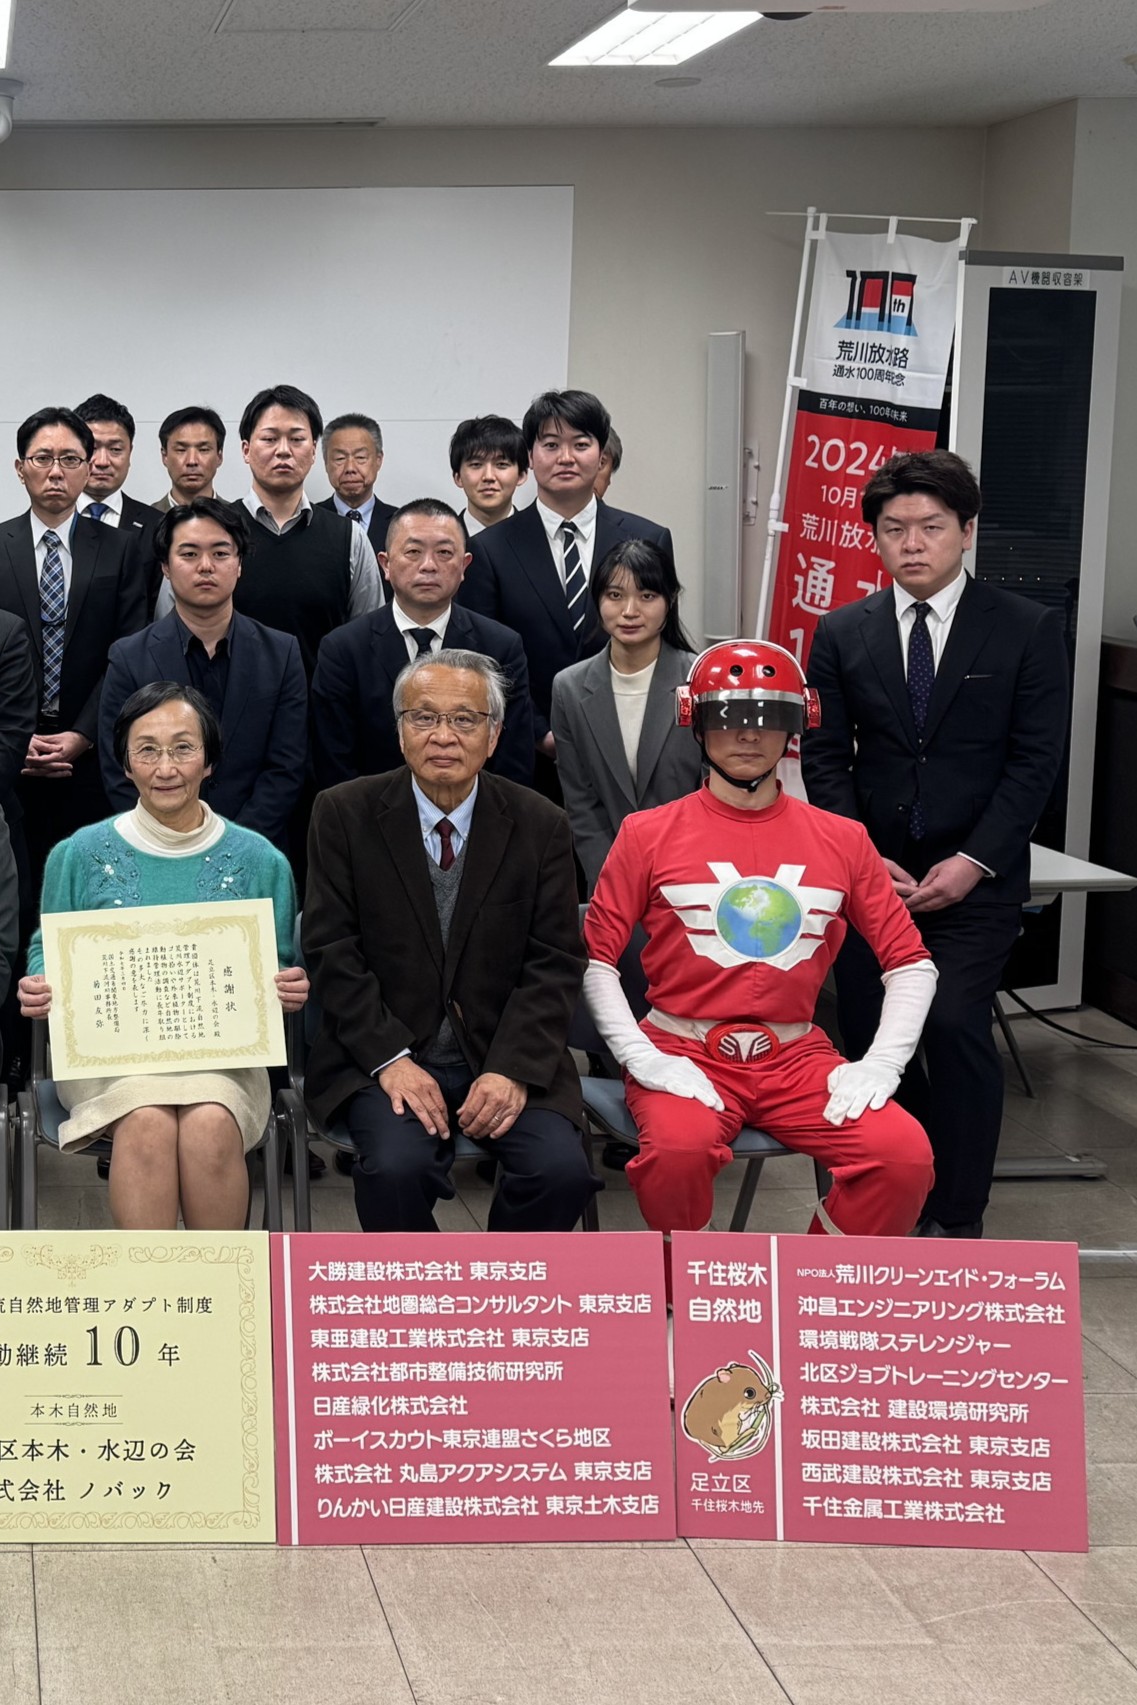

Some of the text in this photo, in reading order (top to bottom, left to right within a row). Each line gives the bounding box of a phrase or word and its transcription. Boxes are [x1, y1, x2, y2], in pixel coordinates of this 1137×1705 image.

[129, 948, 138, 1012] 感謝の意を表します
[160, 946, 173, 1040] 動植物の調査など自然地の
[176, 945, 189, 1039] 荒川水辺サポーターとして
[183, 945, 196, 1038] 管理アダプト制度における
[223, 966, 237, 1012] 感謝状
[308, 1261, 547, 1282] 大勝建設株式会社 東京支店
[687, 1261, 768, 1287] 千住桜木
[309, 1294, 652, 1316] 株式会社地圏総合コンサルタント 東京支店
[689, 1298, 763, 1324] 自然地
[798, 1296, 1066, 1324] 沖昌エンジニアリング株式会社
[85, 1325, 141, 1367] 10
[157, 1343, 181, 1366] 年
[310, 1327, 589, 1349] 東亜建設工業株式会社 東京支店
[799, 1330, 1011, 1353] 環境戦隊ステレンジャー
[312, 1361, 564, 1383] 株式会社都市整備技術研究所
[800, 1362, 1069, 1390] 北区ジョブトレーニングセンター
[30, 1402, 118, 1418] 本木自然地
[313, 1395, 468, 1417] 日産緑化株式会社
[801, 1396, 1028, 1423] 株式会社 建設環境研究所
[314, 1428, 611, 1450] ボーイスカウト東京連盟さくら地区
[801, 1429, 1051, 1459] 坂田建設株式会社 東京支店
[314, 1461, 652, 1484] 株式会社 丸島アクアシステム 東京支店
[690, 1472, 751, 1494] 足立区
[801, 1463, 1052, 1492] 西武建設株式会社 東京支店
[79, 1480, 172, 1501] ノバック
[317, 1494, 659, 1519] りんかい日産建設株式会社 東京土木支店
[691, 1498, 765, 1514] 千住桜木地先
[803, 1496, 1006, 1524] 千住金属工業株式会社
